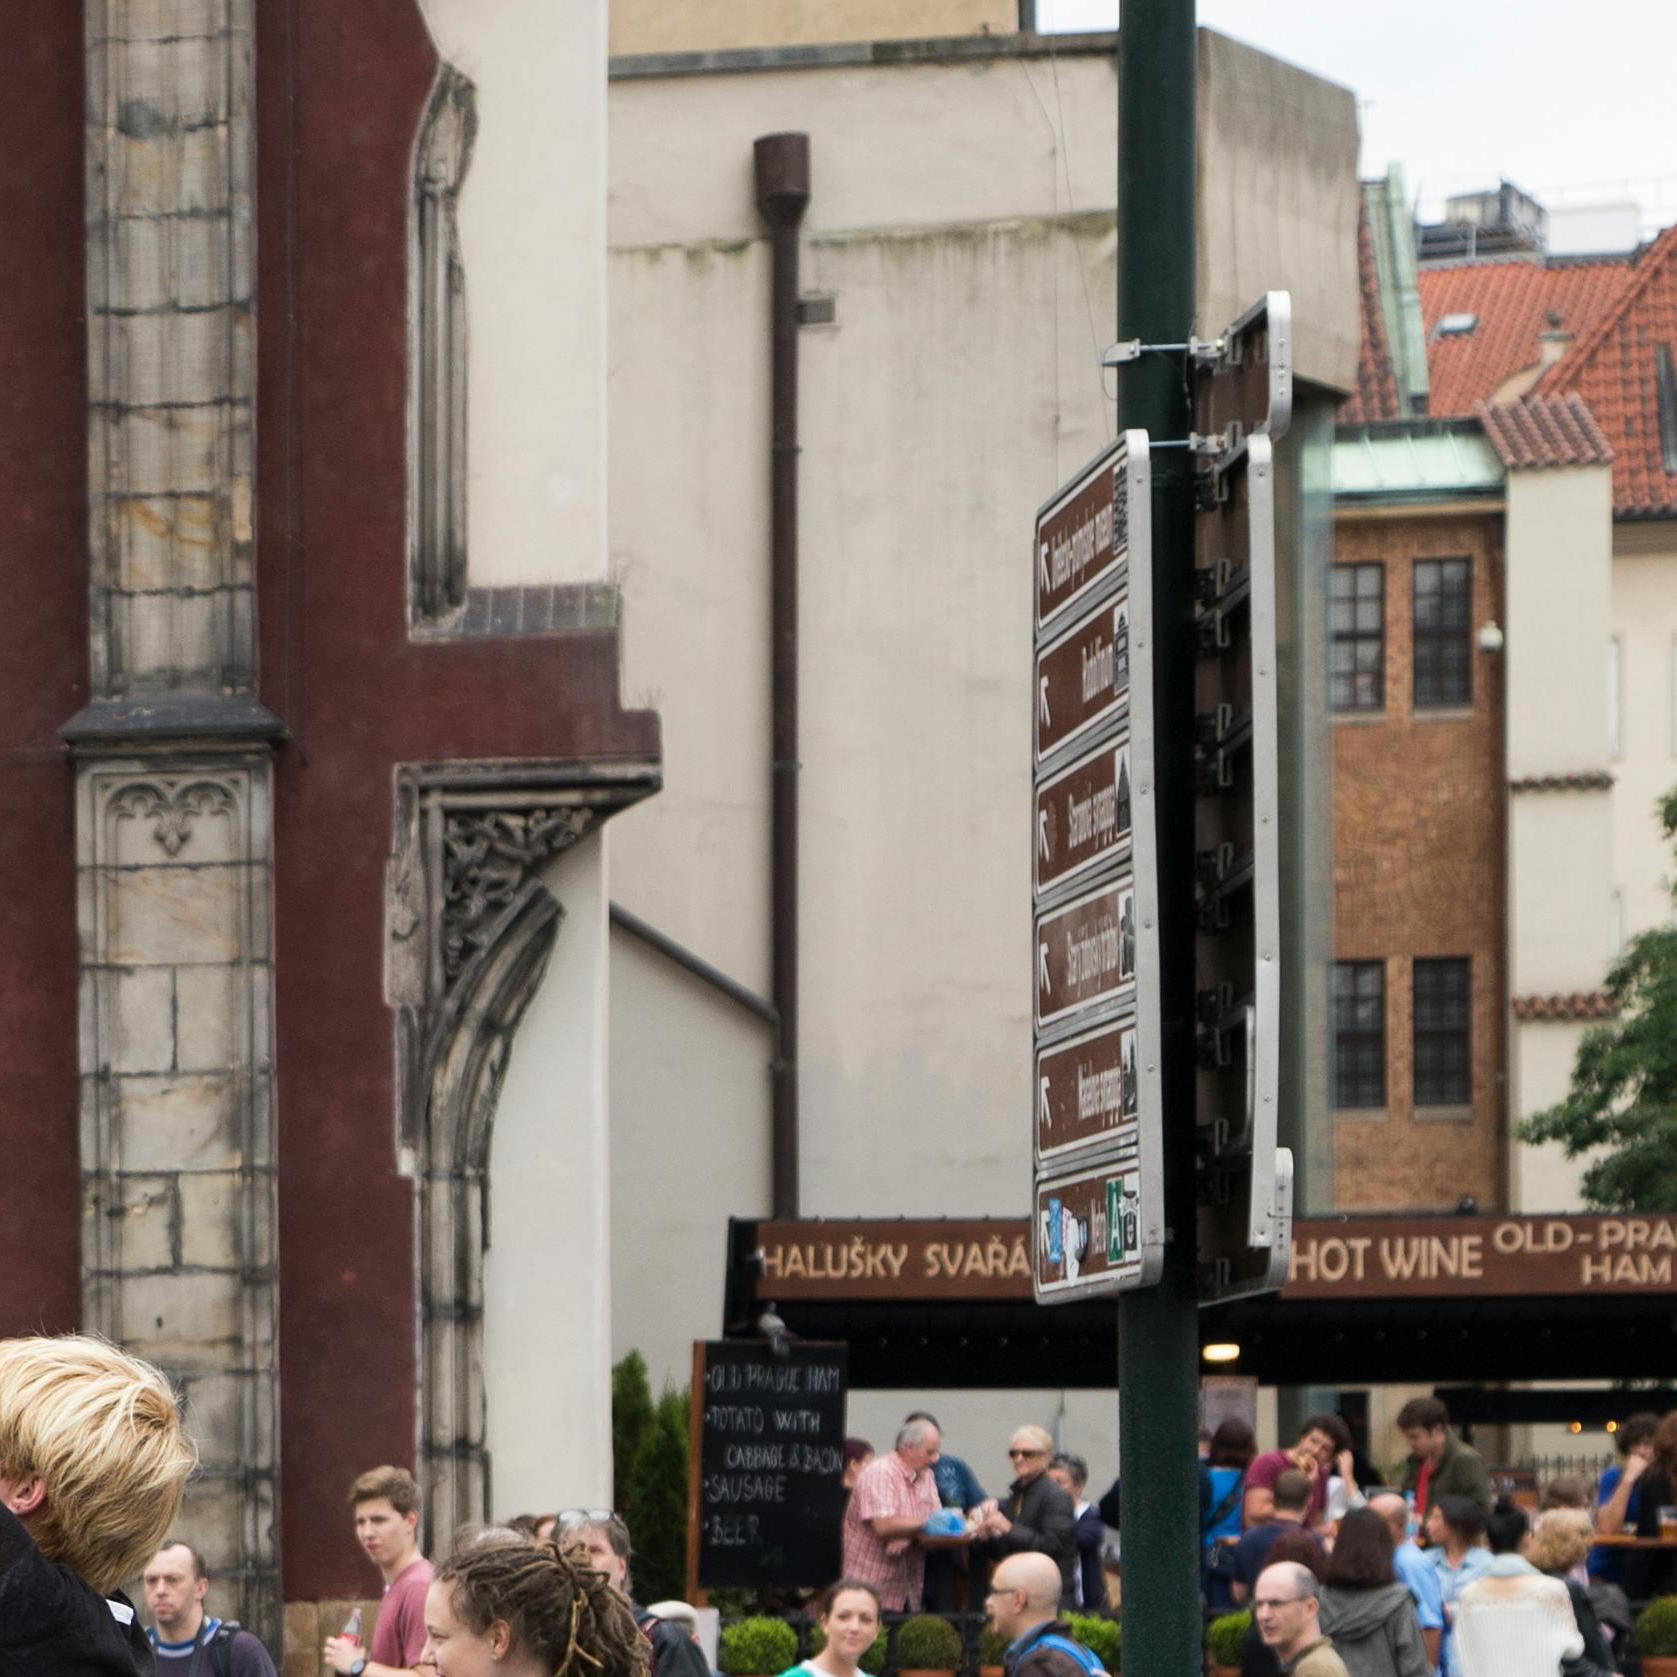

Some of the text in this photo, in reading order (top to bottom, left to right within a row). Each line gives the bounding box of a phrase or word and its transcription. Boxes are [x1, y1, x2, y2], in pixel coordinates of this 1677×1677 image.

[761, 1235, 908, 1279] HALUŠKY
[1290, 1235, 1483, 1281] HOT WINE
[1581, 1253, 1672, 1285] HAM
[711, 1364, 742, 1392] OLD
[807, 1366, 840, 1393] HAM
[710, 1405, 765, 1434] POTATO
[726, 1443, 786, 1470] CABBAGE
[803, 1445, 844, 1475] BACON
[708, 1474, 787, 1503] SAUSAGE
[710, 1514, 761, 1546] BEER
